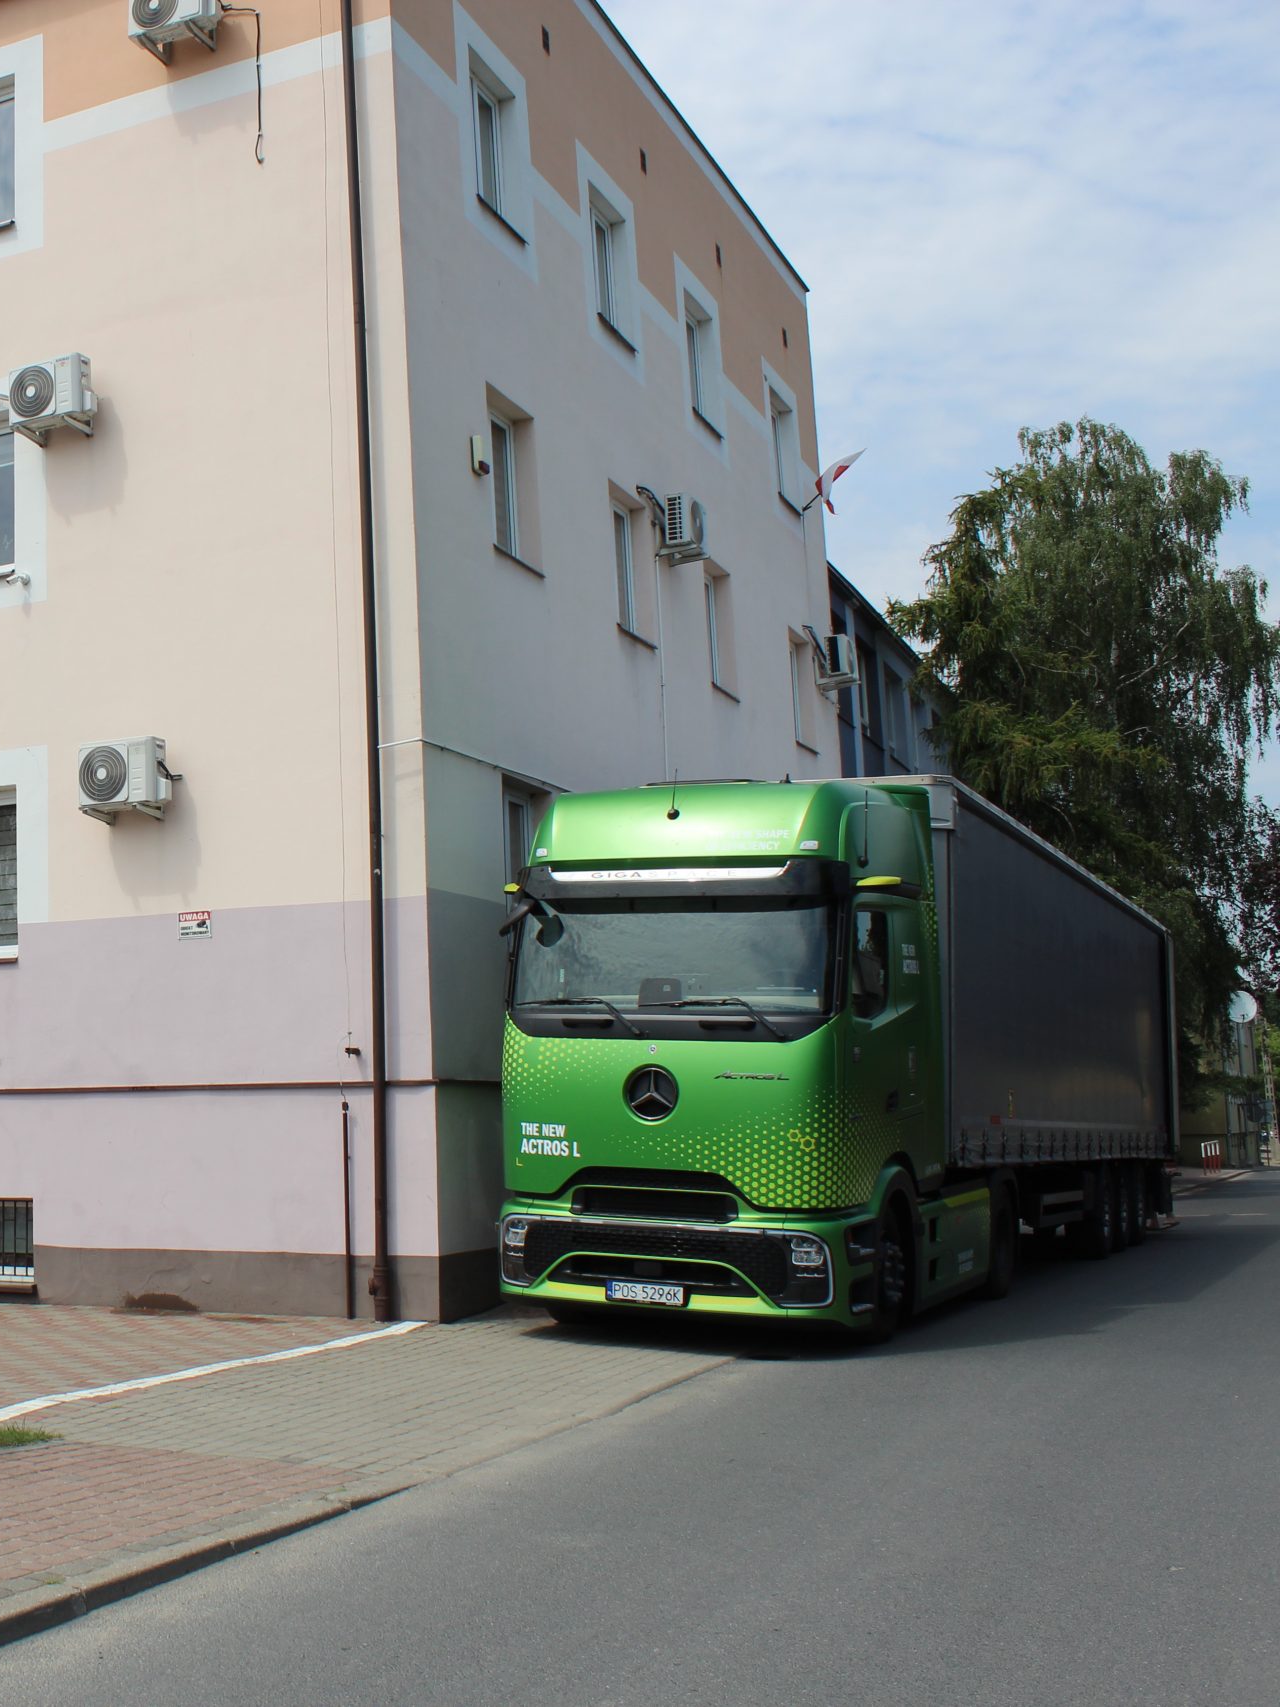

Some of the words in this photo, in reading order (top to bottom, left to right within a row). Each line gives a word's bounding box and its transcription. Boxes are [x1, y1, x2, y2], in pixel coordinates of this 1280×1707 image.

[180, 912, 209, 921] UWAGA
[521, 1122, 540, 1136] THE
[541, 1123, 566, 1138] NEW
[520, 1138, 570, 1157] ACTROS
[572, 1141, 581, 1158] L
[613, 1283, 638, 1299] POS
[641, 1286, 681, 1302] 5296K
